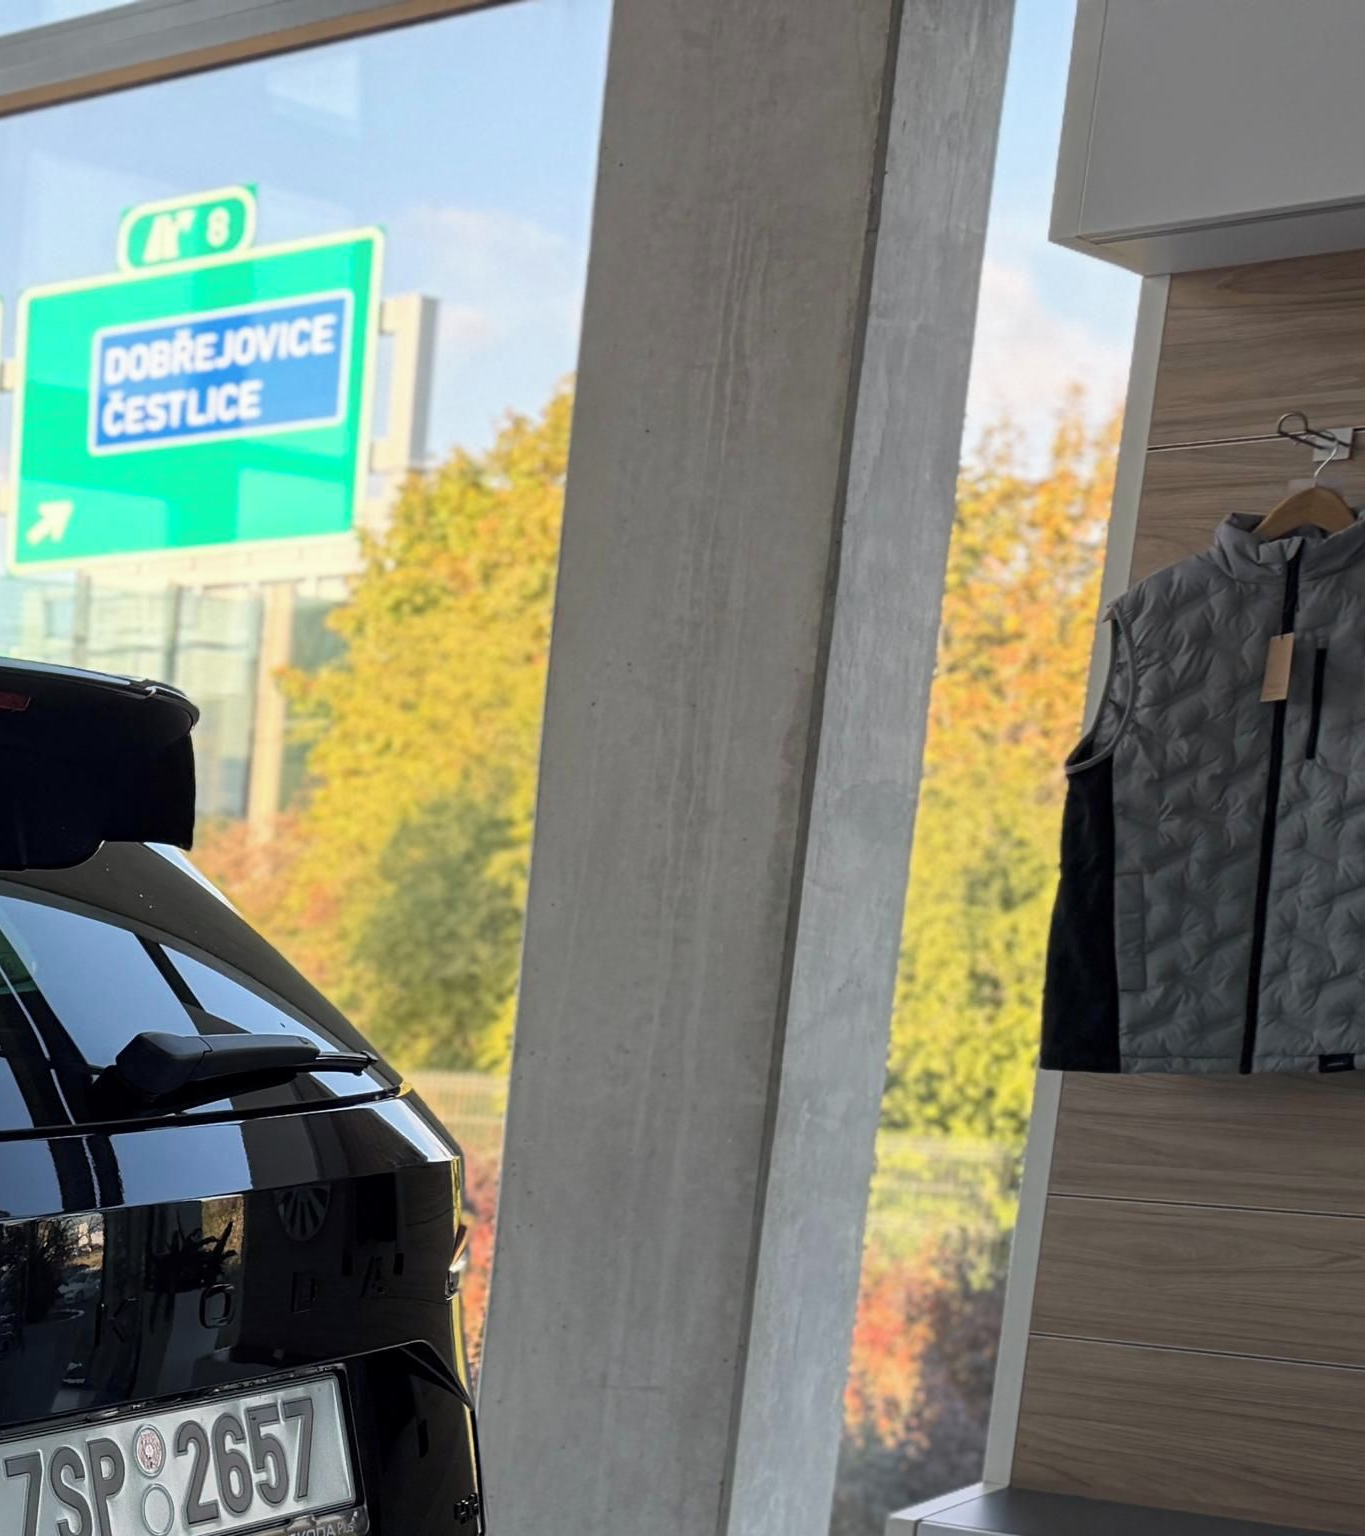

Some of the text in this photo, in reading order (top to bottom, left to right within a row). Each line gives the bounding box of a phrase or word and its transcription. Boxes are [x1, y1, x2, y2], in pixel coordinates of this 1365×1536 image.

[103, 313, 338, 386] DOBŘEJOVICE
[102, 379, 265, 437] ČESTLICE
[174, 1397, 315, 1527] 2657
